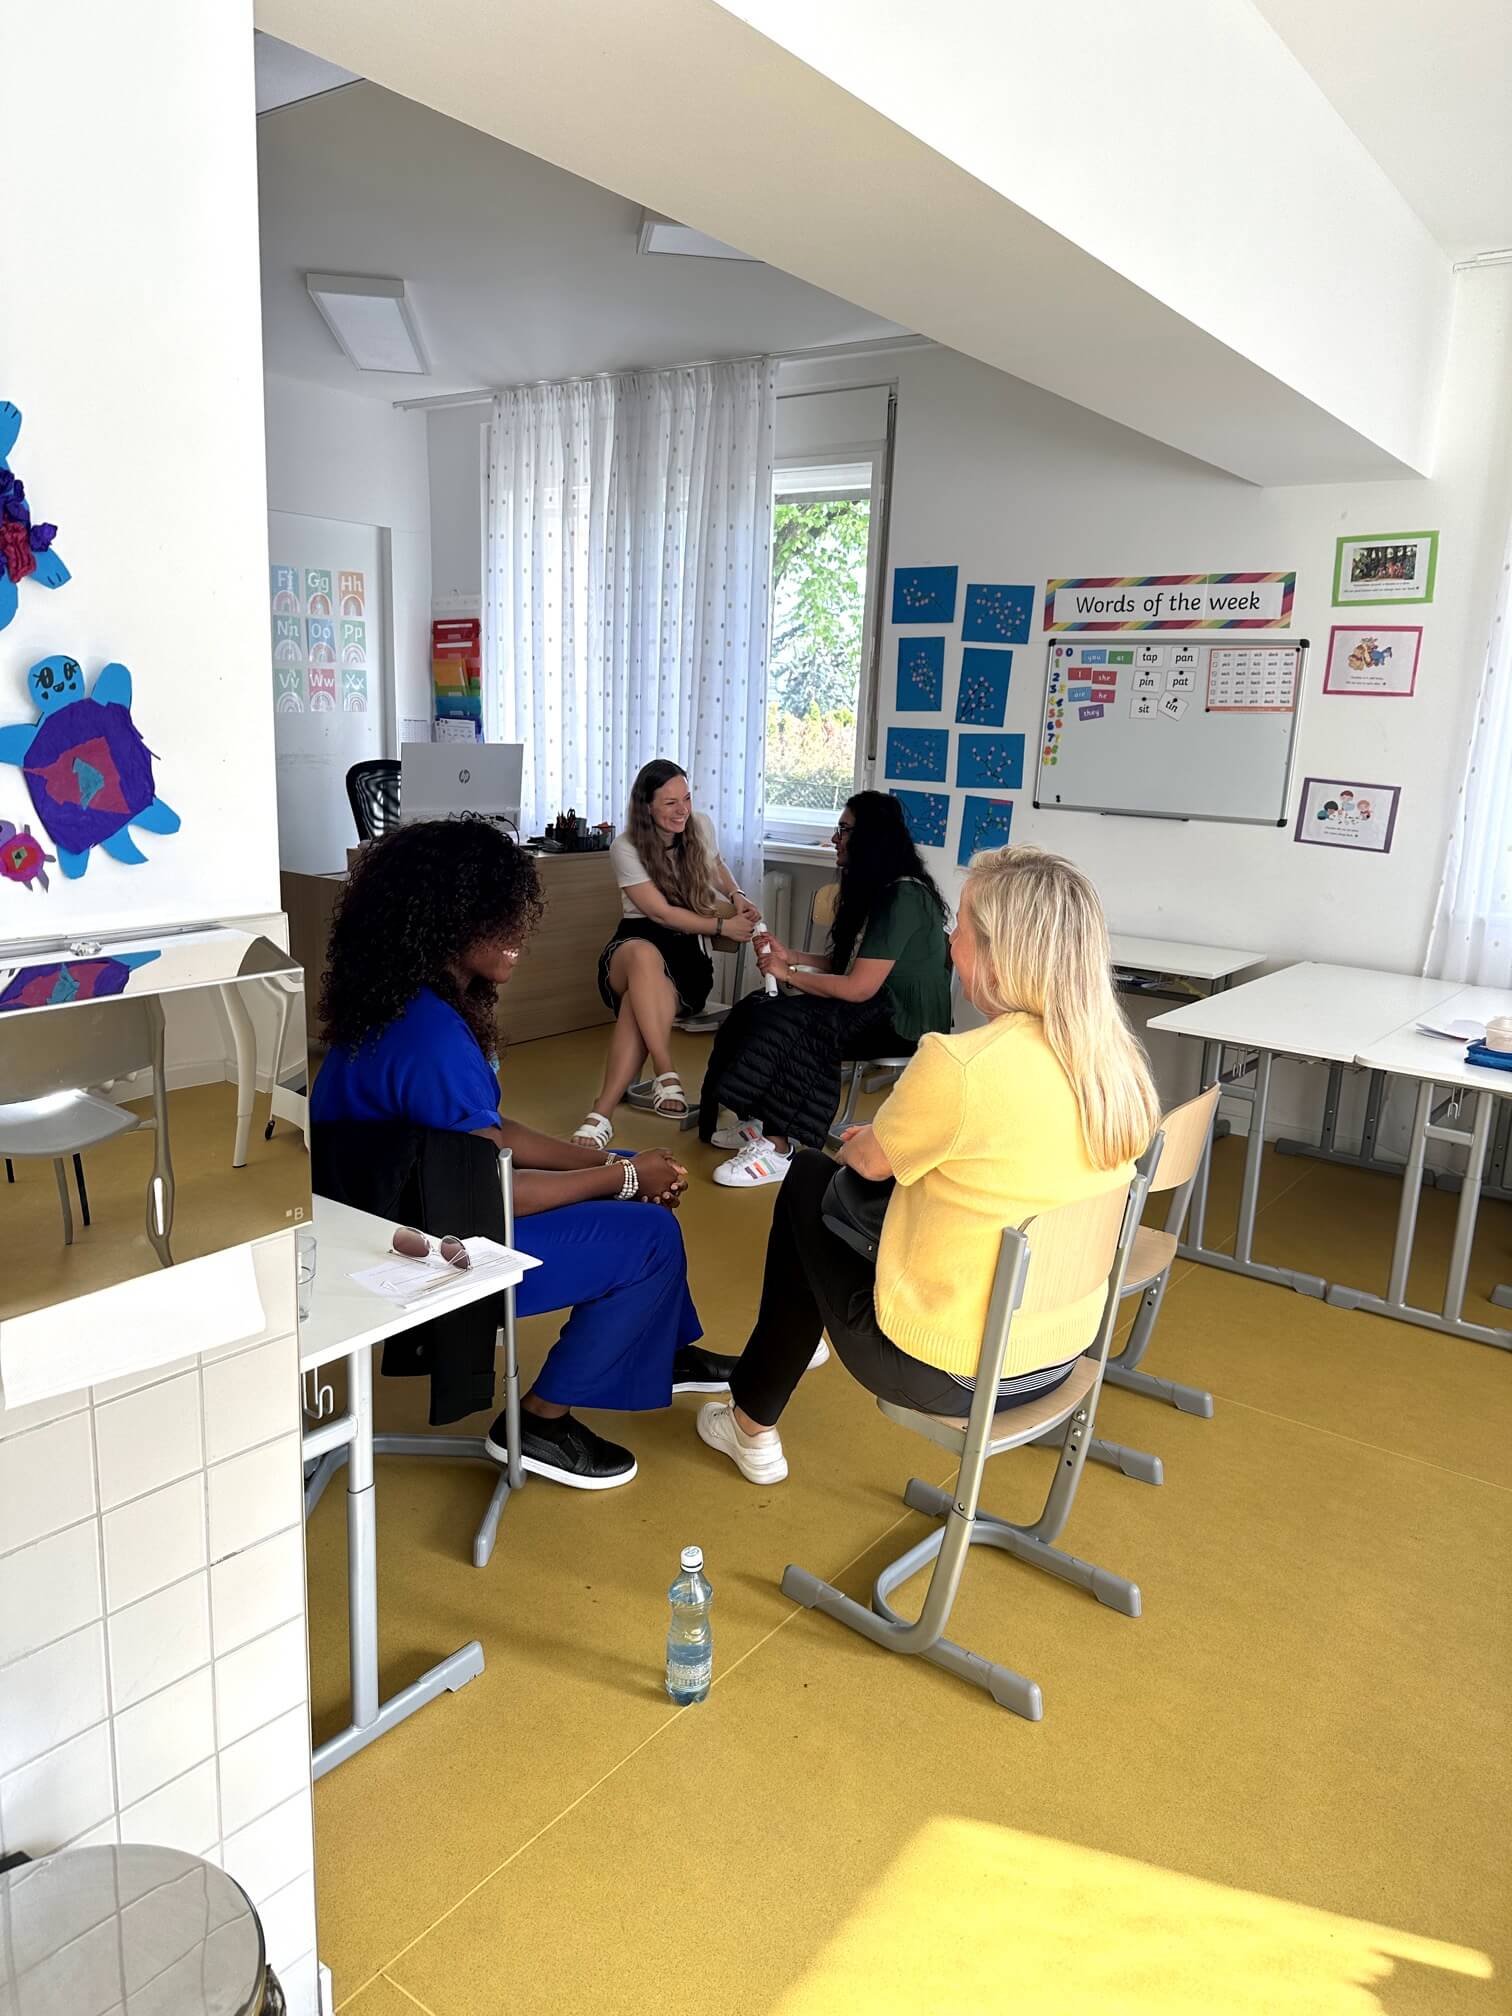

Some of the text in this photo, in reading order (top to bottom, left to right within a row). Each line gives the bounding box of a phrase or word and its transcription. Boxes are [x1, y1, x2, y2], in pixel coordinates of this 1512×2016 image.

[277, 569, 295, 590] Ff
[308, 571, 329, 592] Gg
[341, 575, 363, 592] Hh
[1076, 591, 1261, 616] Words of the week
[277, 620, 299, 637] Nn
[311, 623, 331, 639] Oo
[344, 624, 363, 641] Pp
[1142, 653, 1158, 664] tap
[1175, 655, 1193, 664] pan
[278, 673, 300, 688] Vv
[310, 671, 335, 688] Ww
[345, 673, 364, 689] Xx
[1138, 677, 1154, 687] pin
[1172, 677, 1189, 688] pat
[1138, 704, 1150, 713] sit
[1165, 700, 1178, 712] tin
